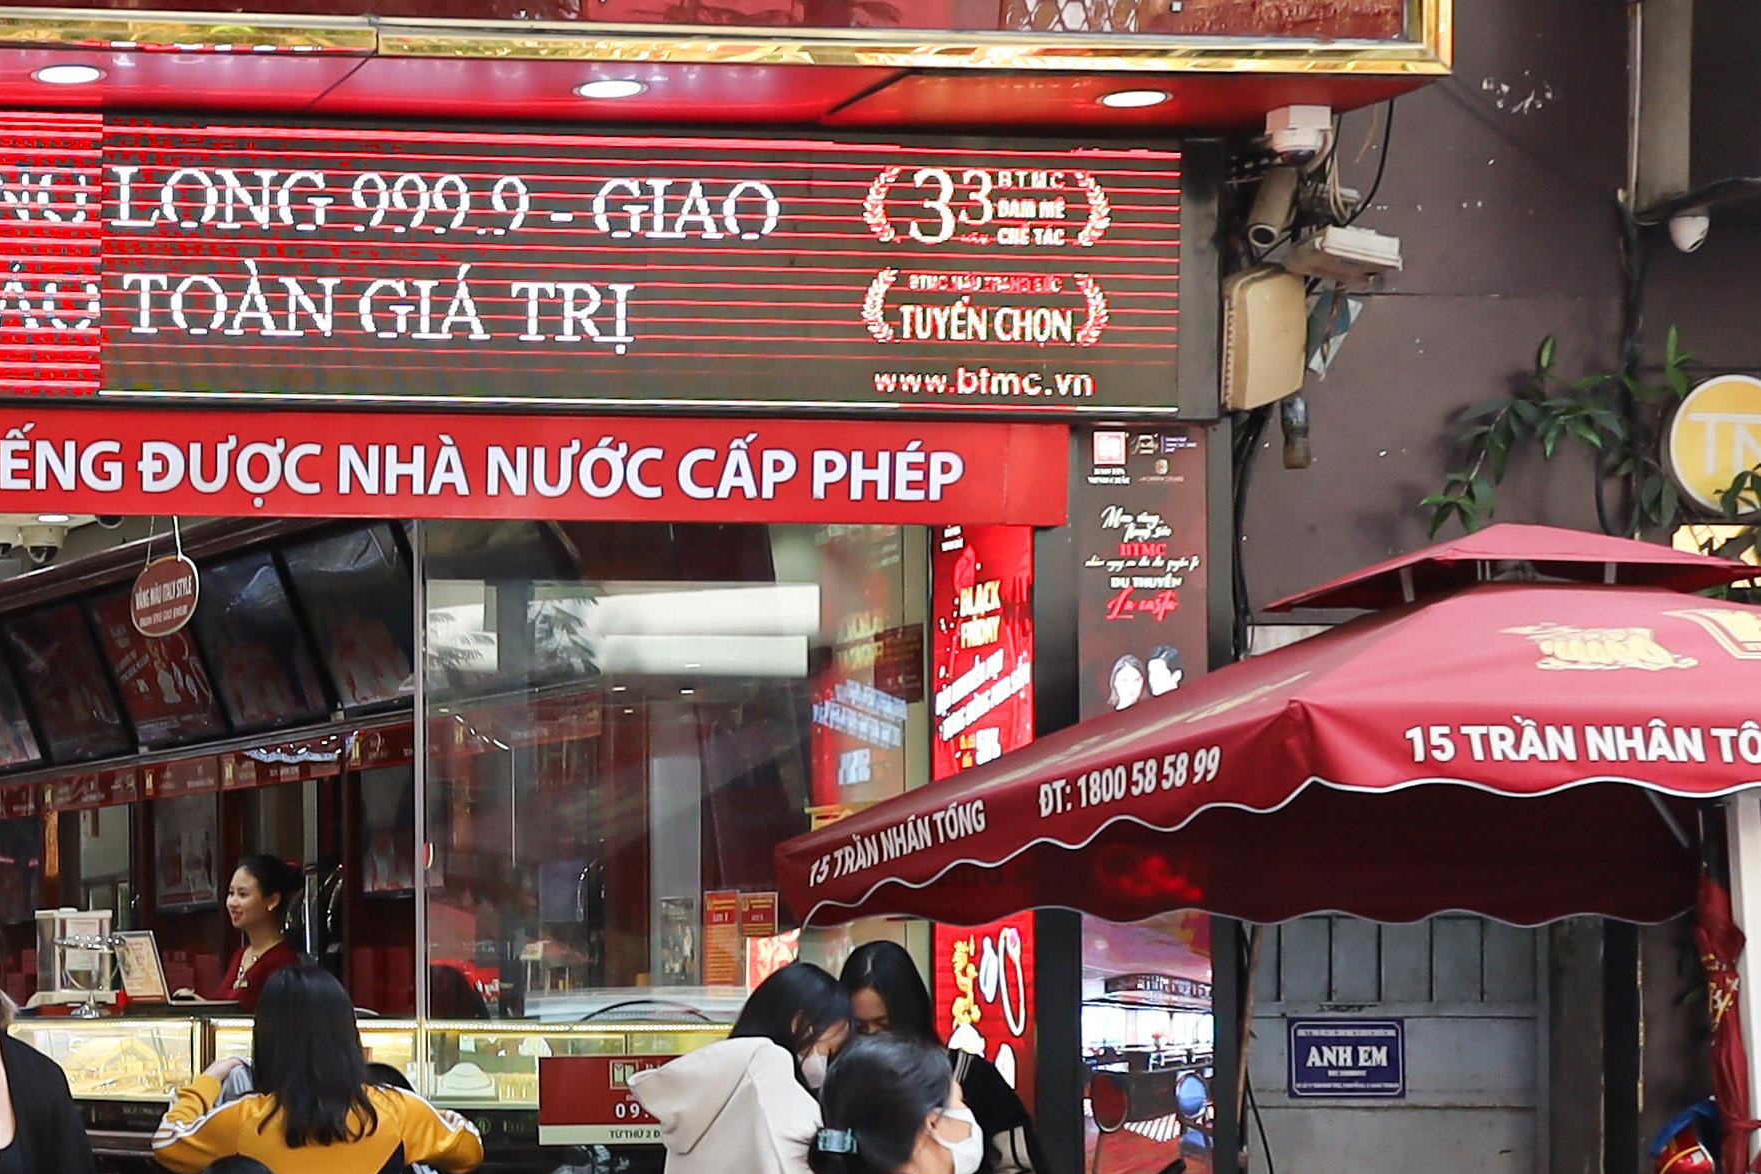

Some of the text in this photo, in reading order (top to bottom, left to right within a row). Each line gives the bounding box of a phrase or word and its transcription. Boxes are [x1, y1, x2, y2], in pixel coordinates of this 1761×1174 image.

[111, 165, 333, 231] LONG
[351, 171, 530, 236] 999.9
[592, 179, 780, 240] GIAO
[998, 171, 1065, 189] BTMC
[909, 168, 993, 244] 33
[122, 257, 341, 338] TOÀN
[358, 263, 491, 341] GIÁ
[511, 281, 636, 356] TRỊ
[994, 307, 1073, 348] CHỌN
[874, 366, 1095, 397] www.btmc.vn
[137, 436, 322, 508] ĐƯỢC
[338, 434, 470, 497] NHÀ
[487, 436, 664, 499] NƯỚC
[677, 432, 798, 500] CẤP
[812, 440, 965, 501] PHÉP
[959, 580, 1001, 617] BLACK
[1406, 723, 1455, 763] 15
[1461, 715, 1578, 762] TRẦN
[1584, 718, 1706, 763] NHÂN
[1038, 745, 1221, 818] ĐT: 1800 58 58 99
[808, 855, 829, 887] 15
[834, 833, 879, 879] TRẦN
[881, 814, 932, 862] NHÂN
[1305, 1045, 1388, 1067] ANH EM
[615, 1102, 650, 1119] 09:
